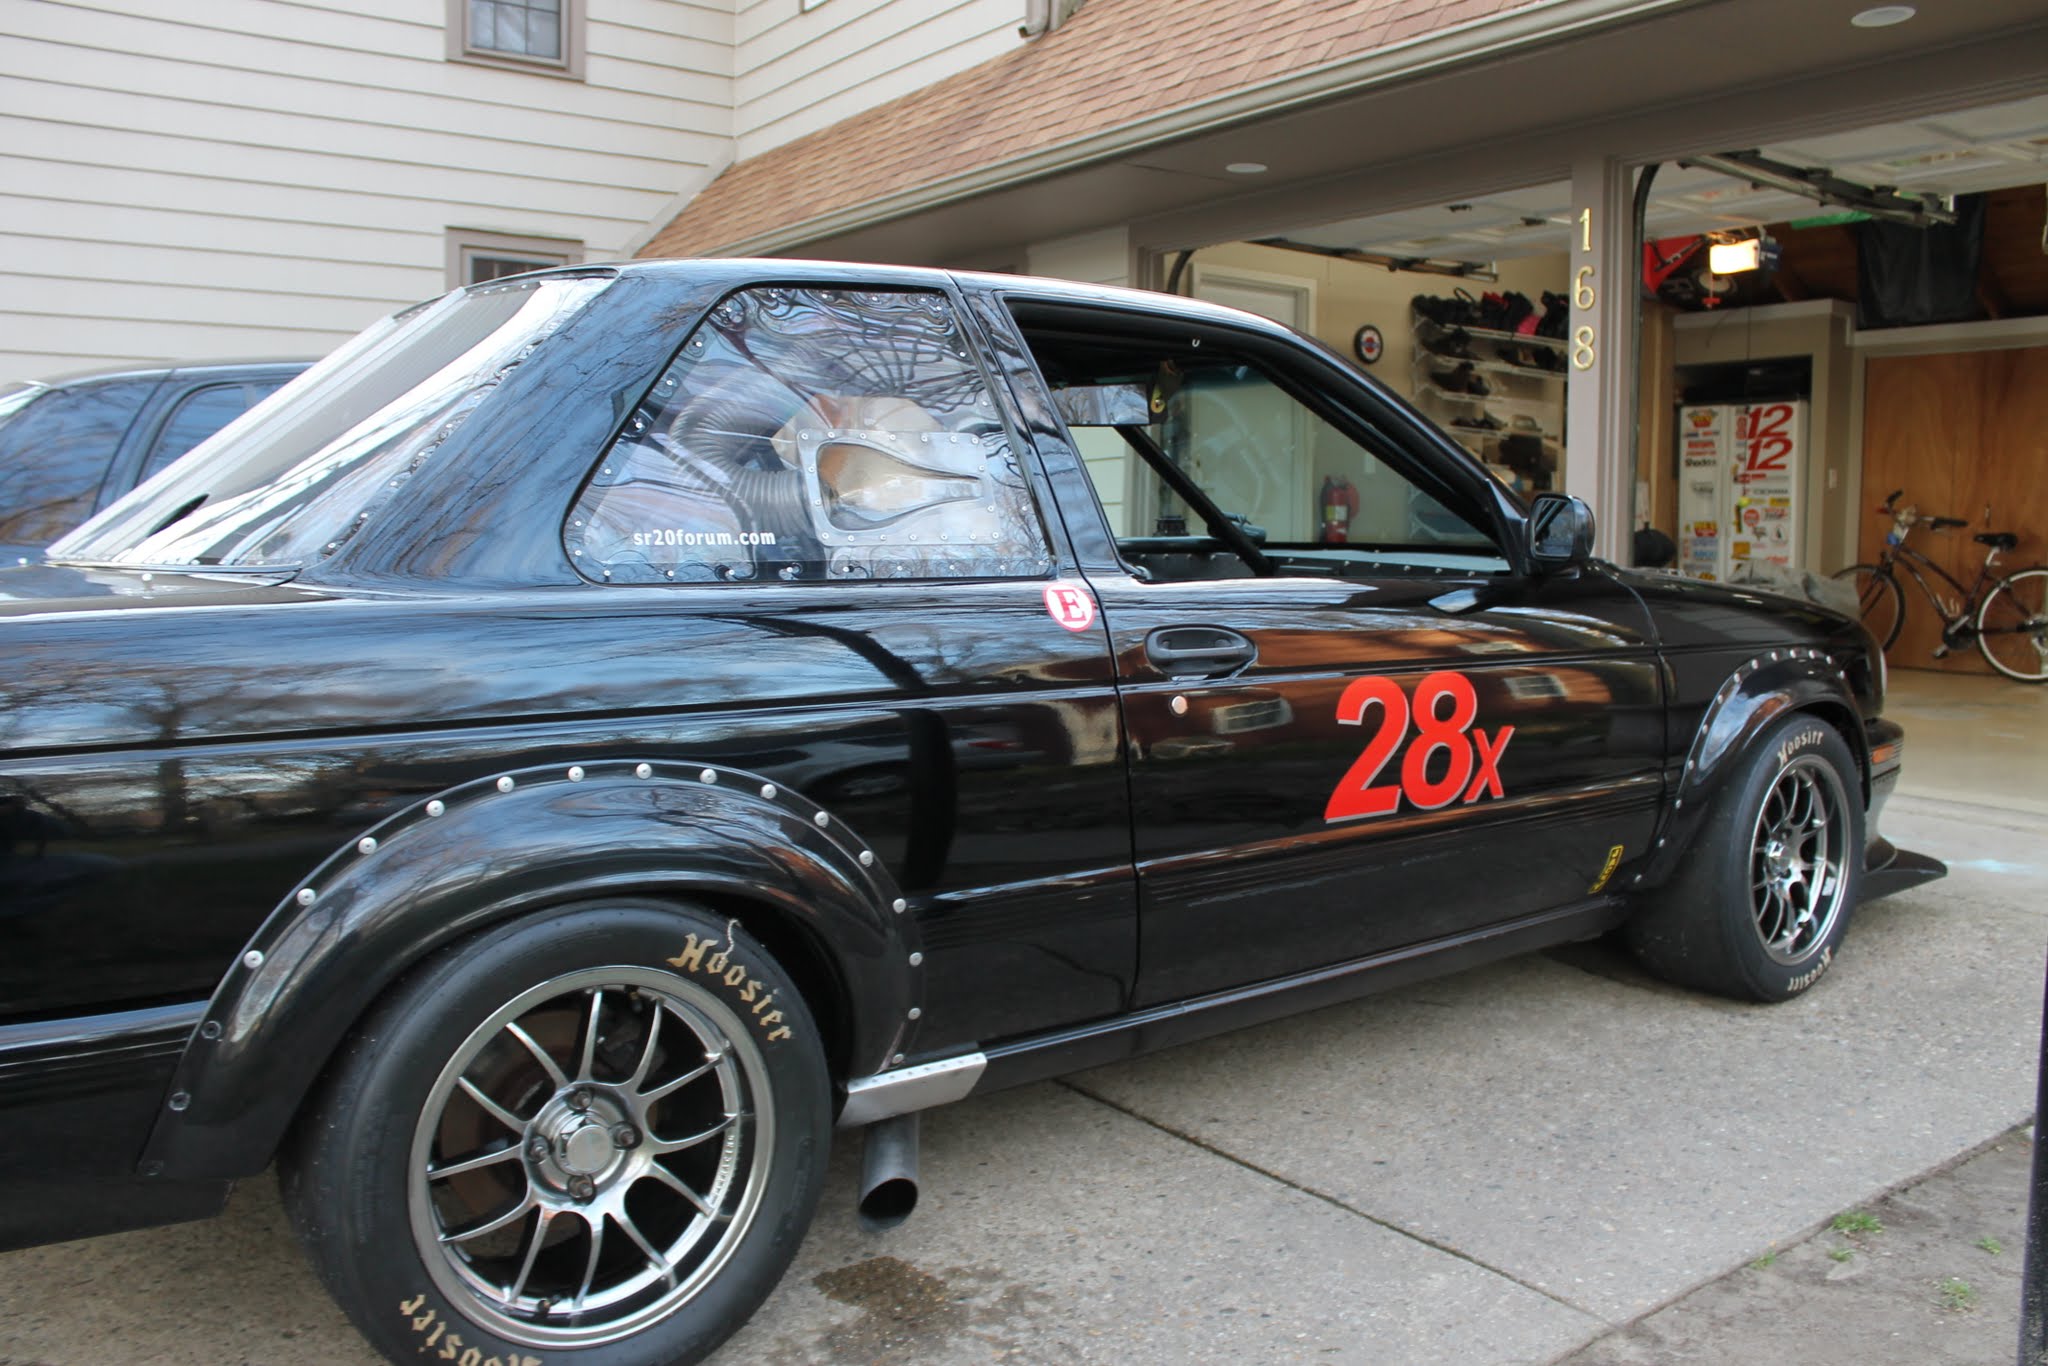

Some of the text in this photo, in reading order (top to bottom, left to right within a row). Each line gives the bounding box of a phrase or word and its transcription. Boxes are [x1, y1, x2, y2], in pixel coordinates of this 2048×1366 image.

[1573, 207, 1595, 372] 168
[1747, 403, 1793, 439] 12
[1747, 438, 1793, 471] 12
[633, 529, 777, 546] sr20forum.com
[665, 932, 792, 1041] Hoosier
